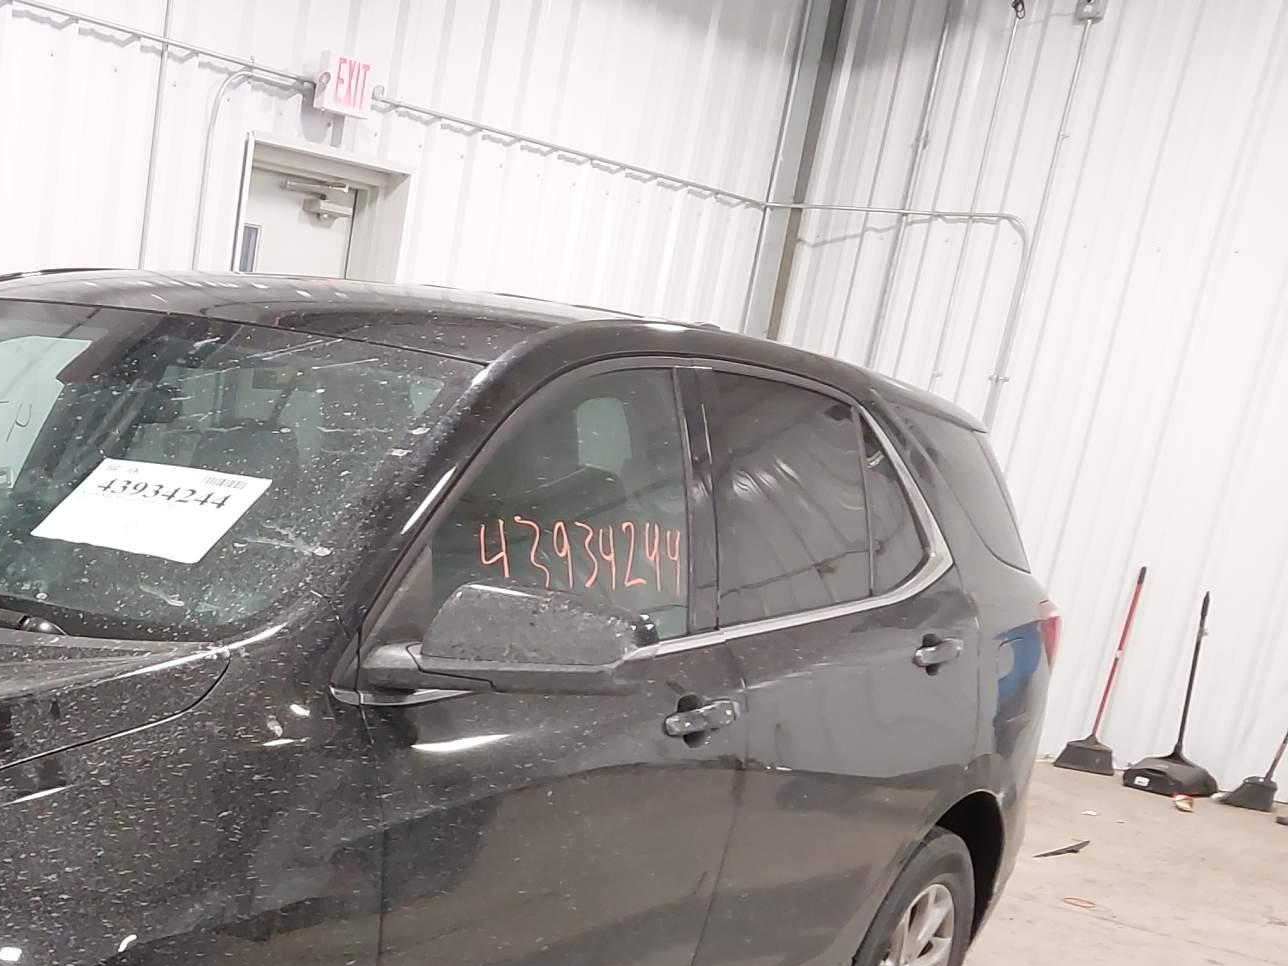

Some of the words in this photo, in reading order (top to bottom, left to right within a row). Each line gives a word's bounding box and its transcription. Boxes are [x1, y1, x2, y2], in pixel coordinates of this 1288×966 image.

[334, 57, 371, 110] EXIT
[97, 477, 232, 510] 43934244
[479, 515, 681, 596] 43934244
